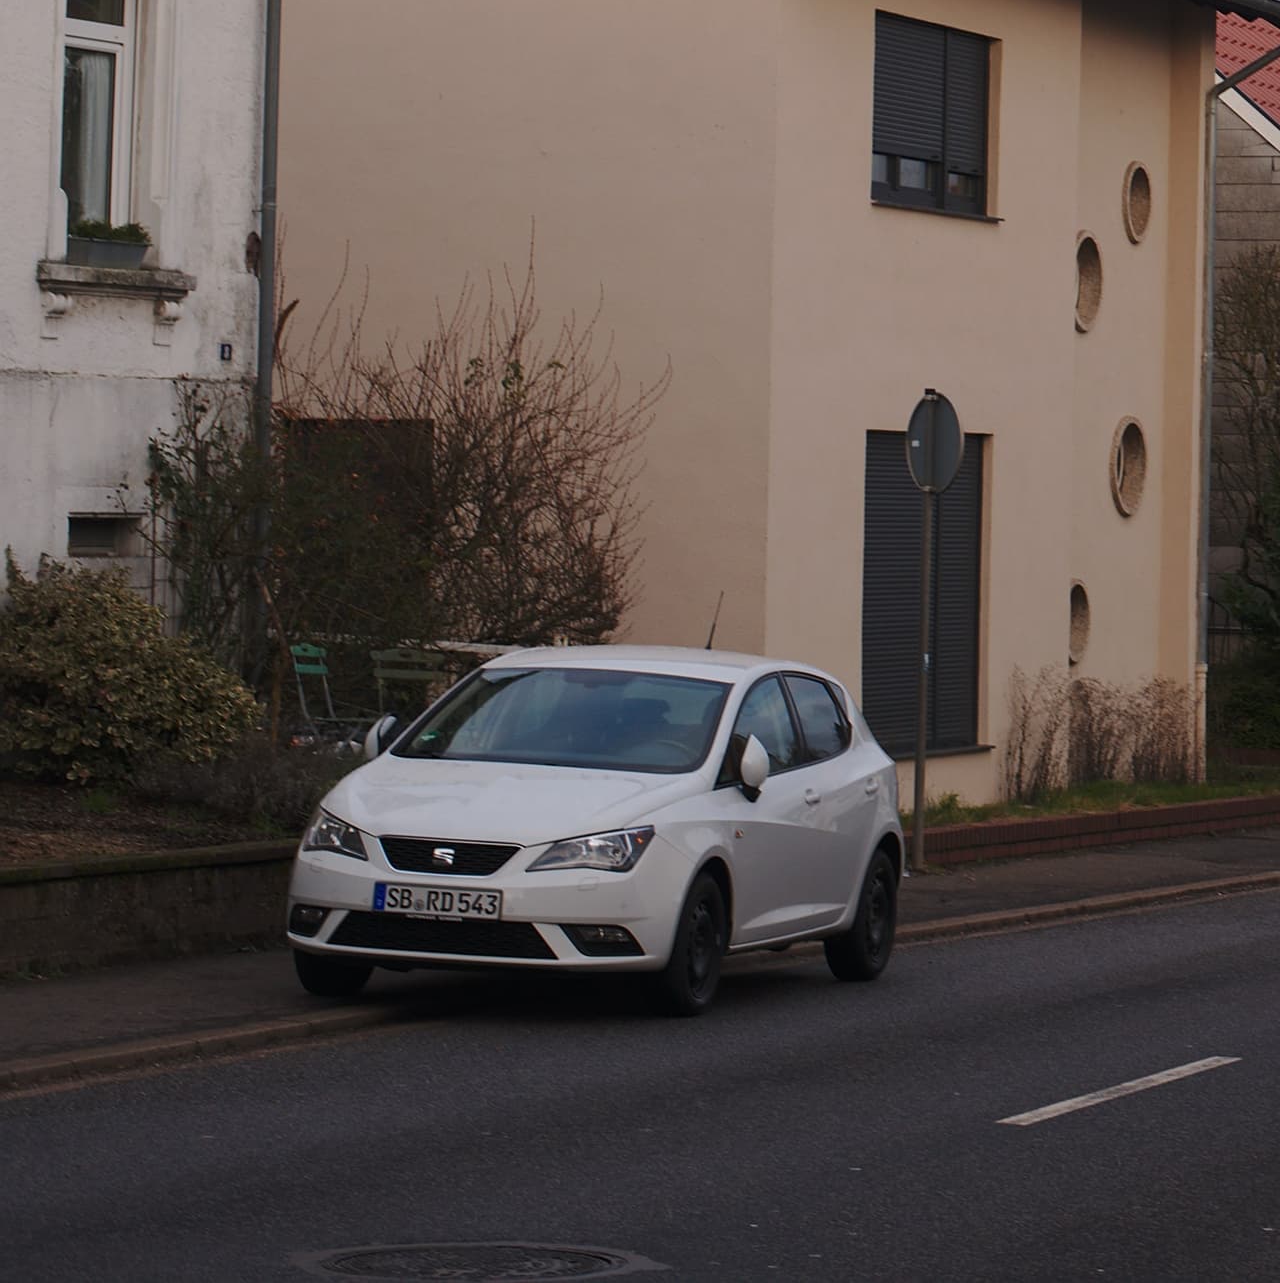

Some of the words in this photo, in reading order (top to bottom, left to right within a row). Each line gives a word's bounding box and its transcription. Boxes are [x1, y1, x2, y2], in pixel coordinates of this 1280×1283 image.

[387, 888, 412, 909] SB
[426, 891, 454, 912] RD
[458, 893, 499, 915] 543
